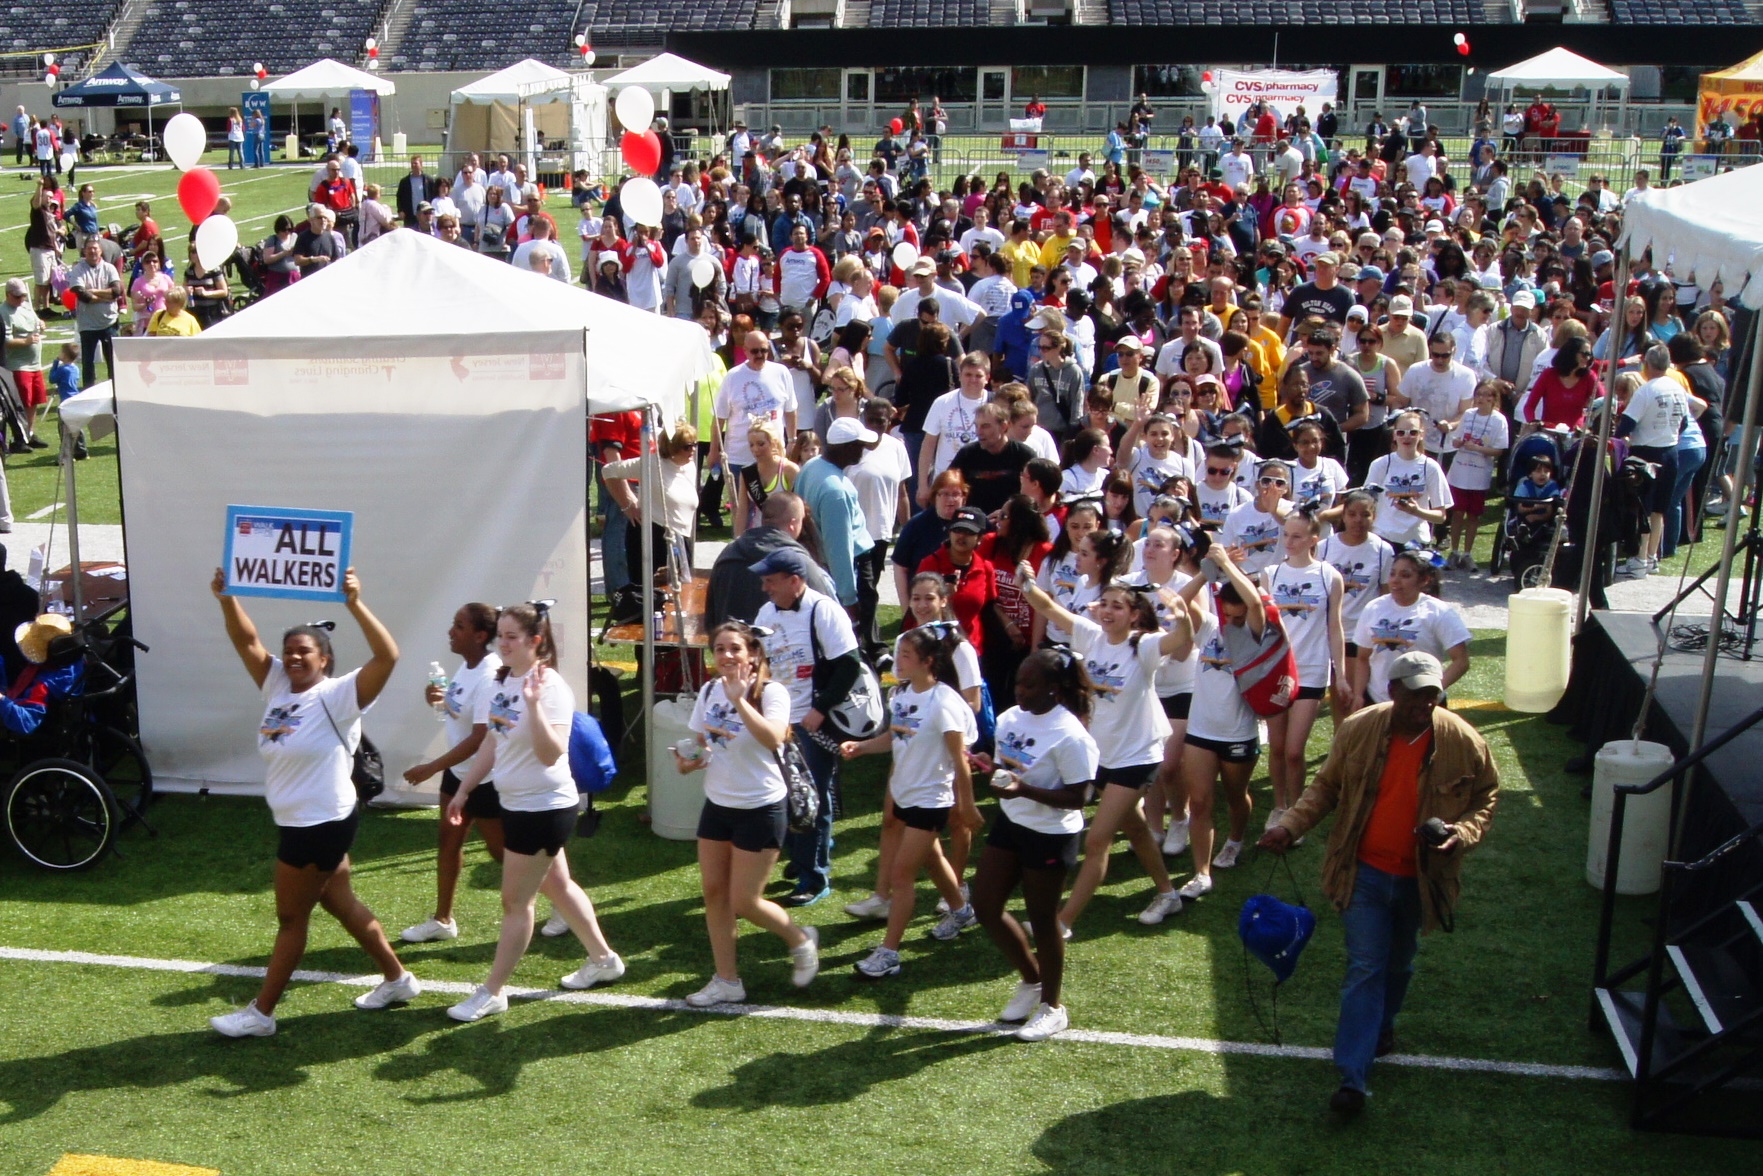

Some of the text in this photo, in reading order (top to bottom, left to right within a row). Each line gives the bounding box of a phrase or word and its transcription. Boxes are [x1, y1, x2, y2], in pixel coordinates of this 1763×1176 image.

[84, 77, 128, 87] Amway
[1235, 81, 1319, 92] CVS/pharmacy
[57, 95, 83, 106] Amway
[117, 94, 143, 105] Amway
[274, 522, 335, 556] ALL
[235, 557, 336, 588] WALKERS
